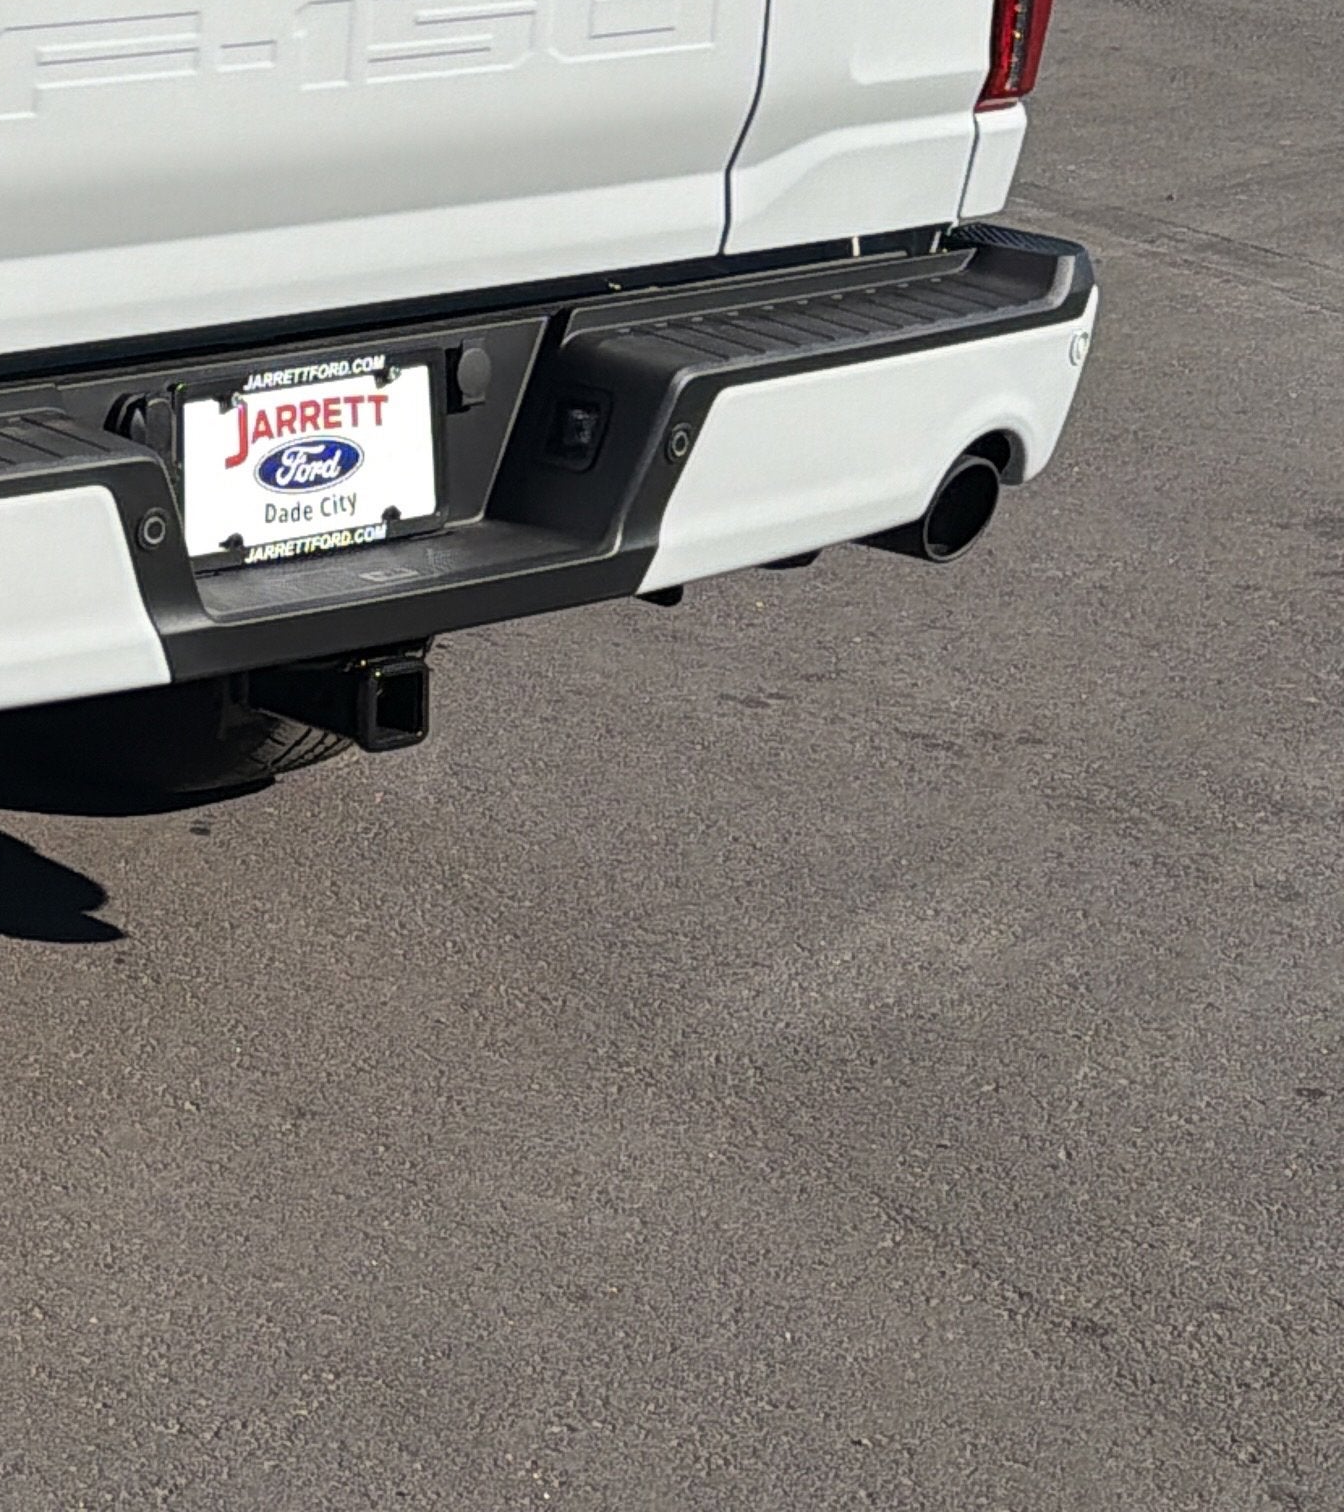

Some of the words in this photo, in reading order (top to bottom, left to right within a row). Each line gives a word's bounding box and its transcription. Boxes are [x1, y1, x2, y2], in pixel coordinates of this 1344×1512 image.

[243, 354, 386, 391] JARRETTFORD.COM
[224, 394, 389, 469] JARRETT
[275, 445, 342, 486] Ford
[264, 499, 313, 524] Dade
[320, 491, 358, 518] City
[244, 523, 387, 564] JARRETTFORD.COM
